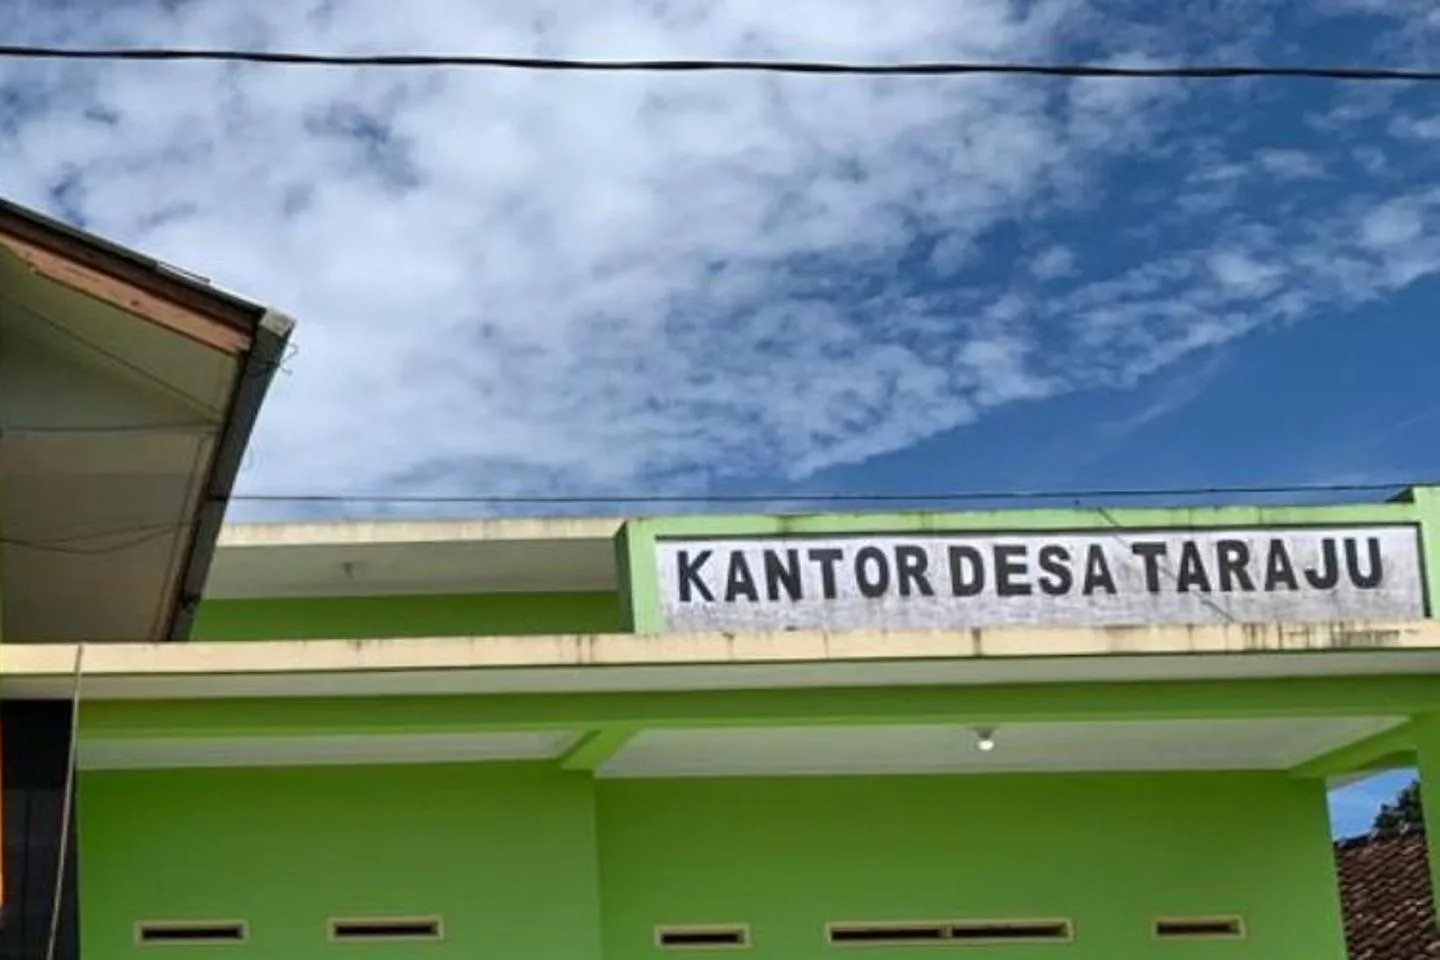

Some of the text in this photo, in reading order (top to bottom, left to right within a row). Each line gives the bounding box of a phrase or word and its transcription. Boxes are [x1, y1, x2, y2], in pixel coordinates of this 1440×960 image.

[676, 537, 1383, 602] KANTOR DESA TARAJU
